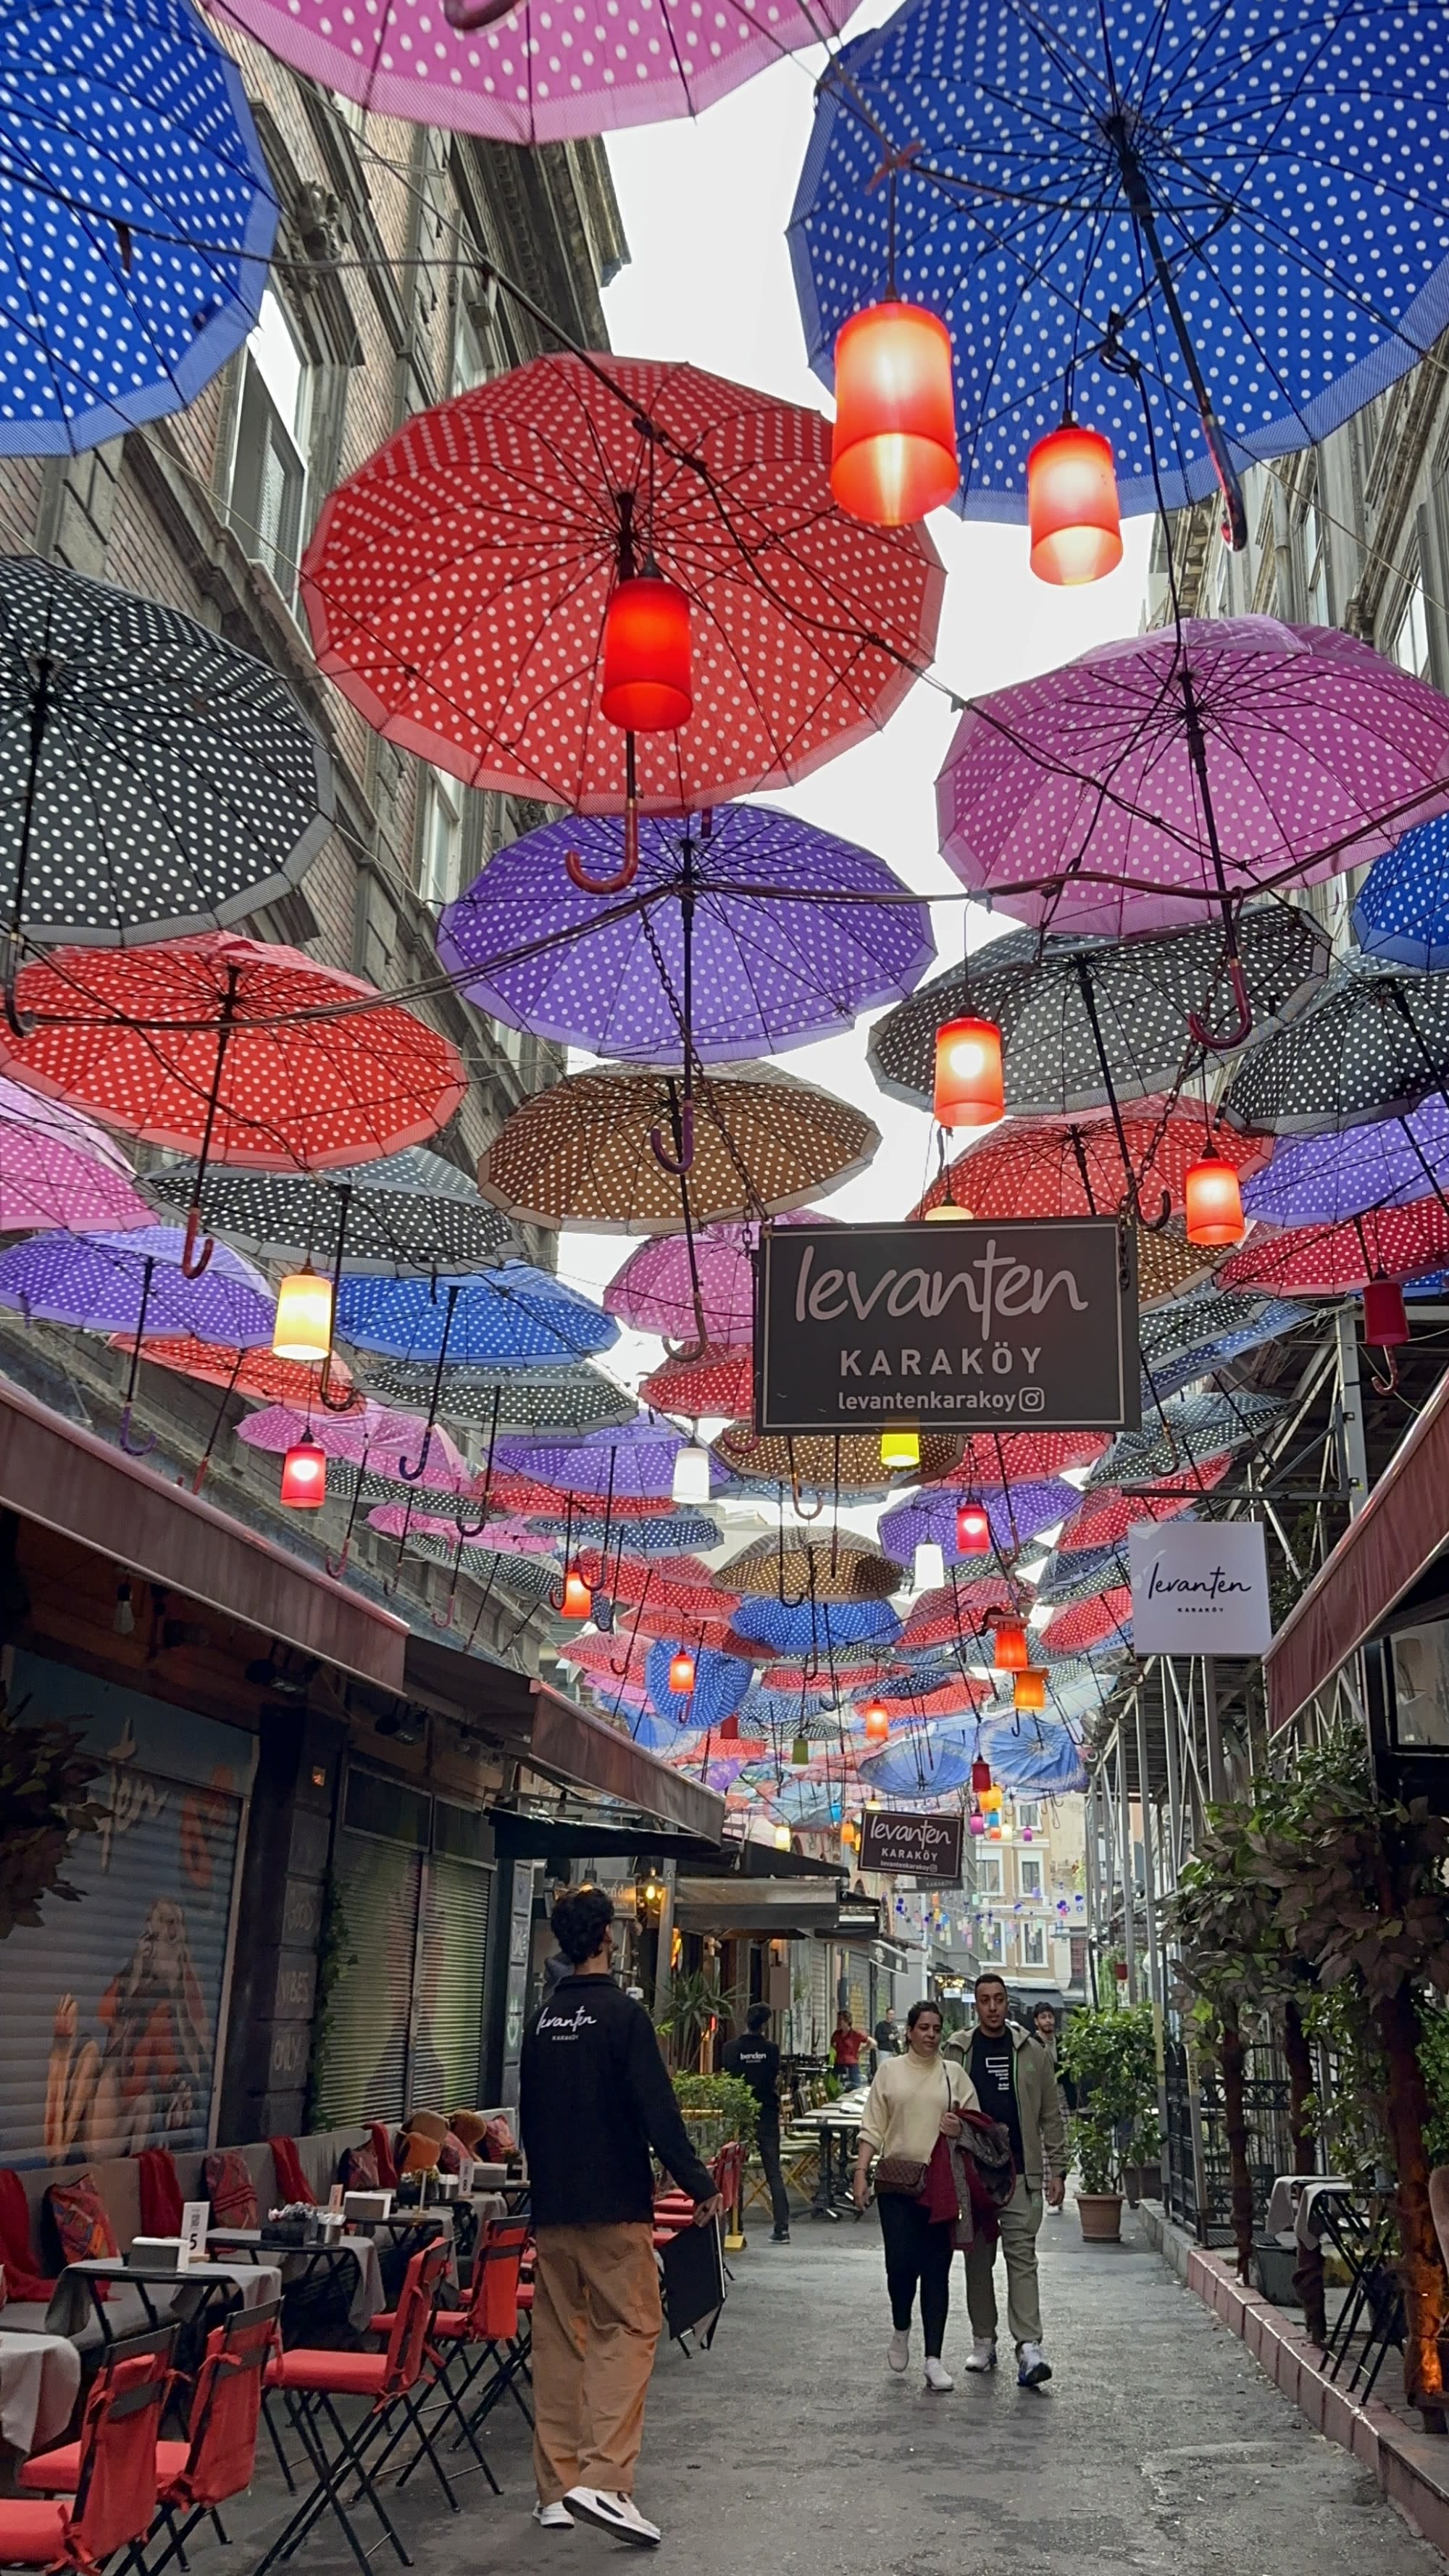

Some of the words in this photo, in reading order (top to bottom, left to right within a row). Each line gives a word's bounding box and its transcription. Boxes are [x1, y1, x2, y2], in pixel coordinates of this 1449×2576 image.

[796, 1238, 1089, 1341] levanten
[840, 1341, 1042, 1376] KARAKÖY
[838, 1390, 1016, 1412] levantenkarakoy
[1148, 1562, 1252, 1600] levanten
[869, 1814, 952, 1850] levanten
[881, 1848, 938, 1862] KARAKÖY
[536, 2005, 598, 2035] levanten
[189, 2233, 199, 2251] 5
